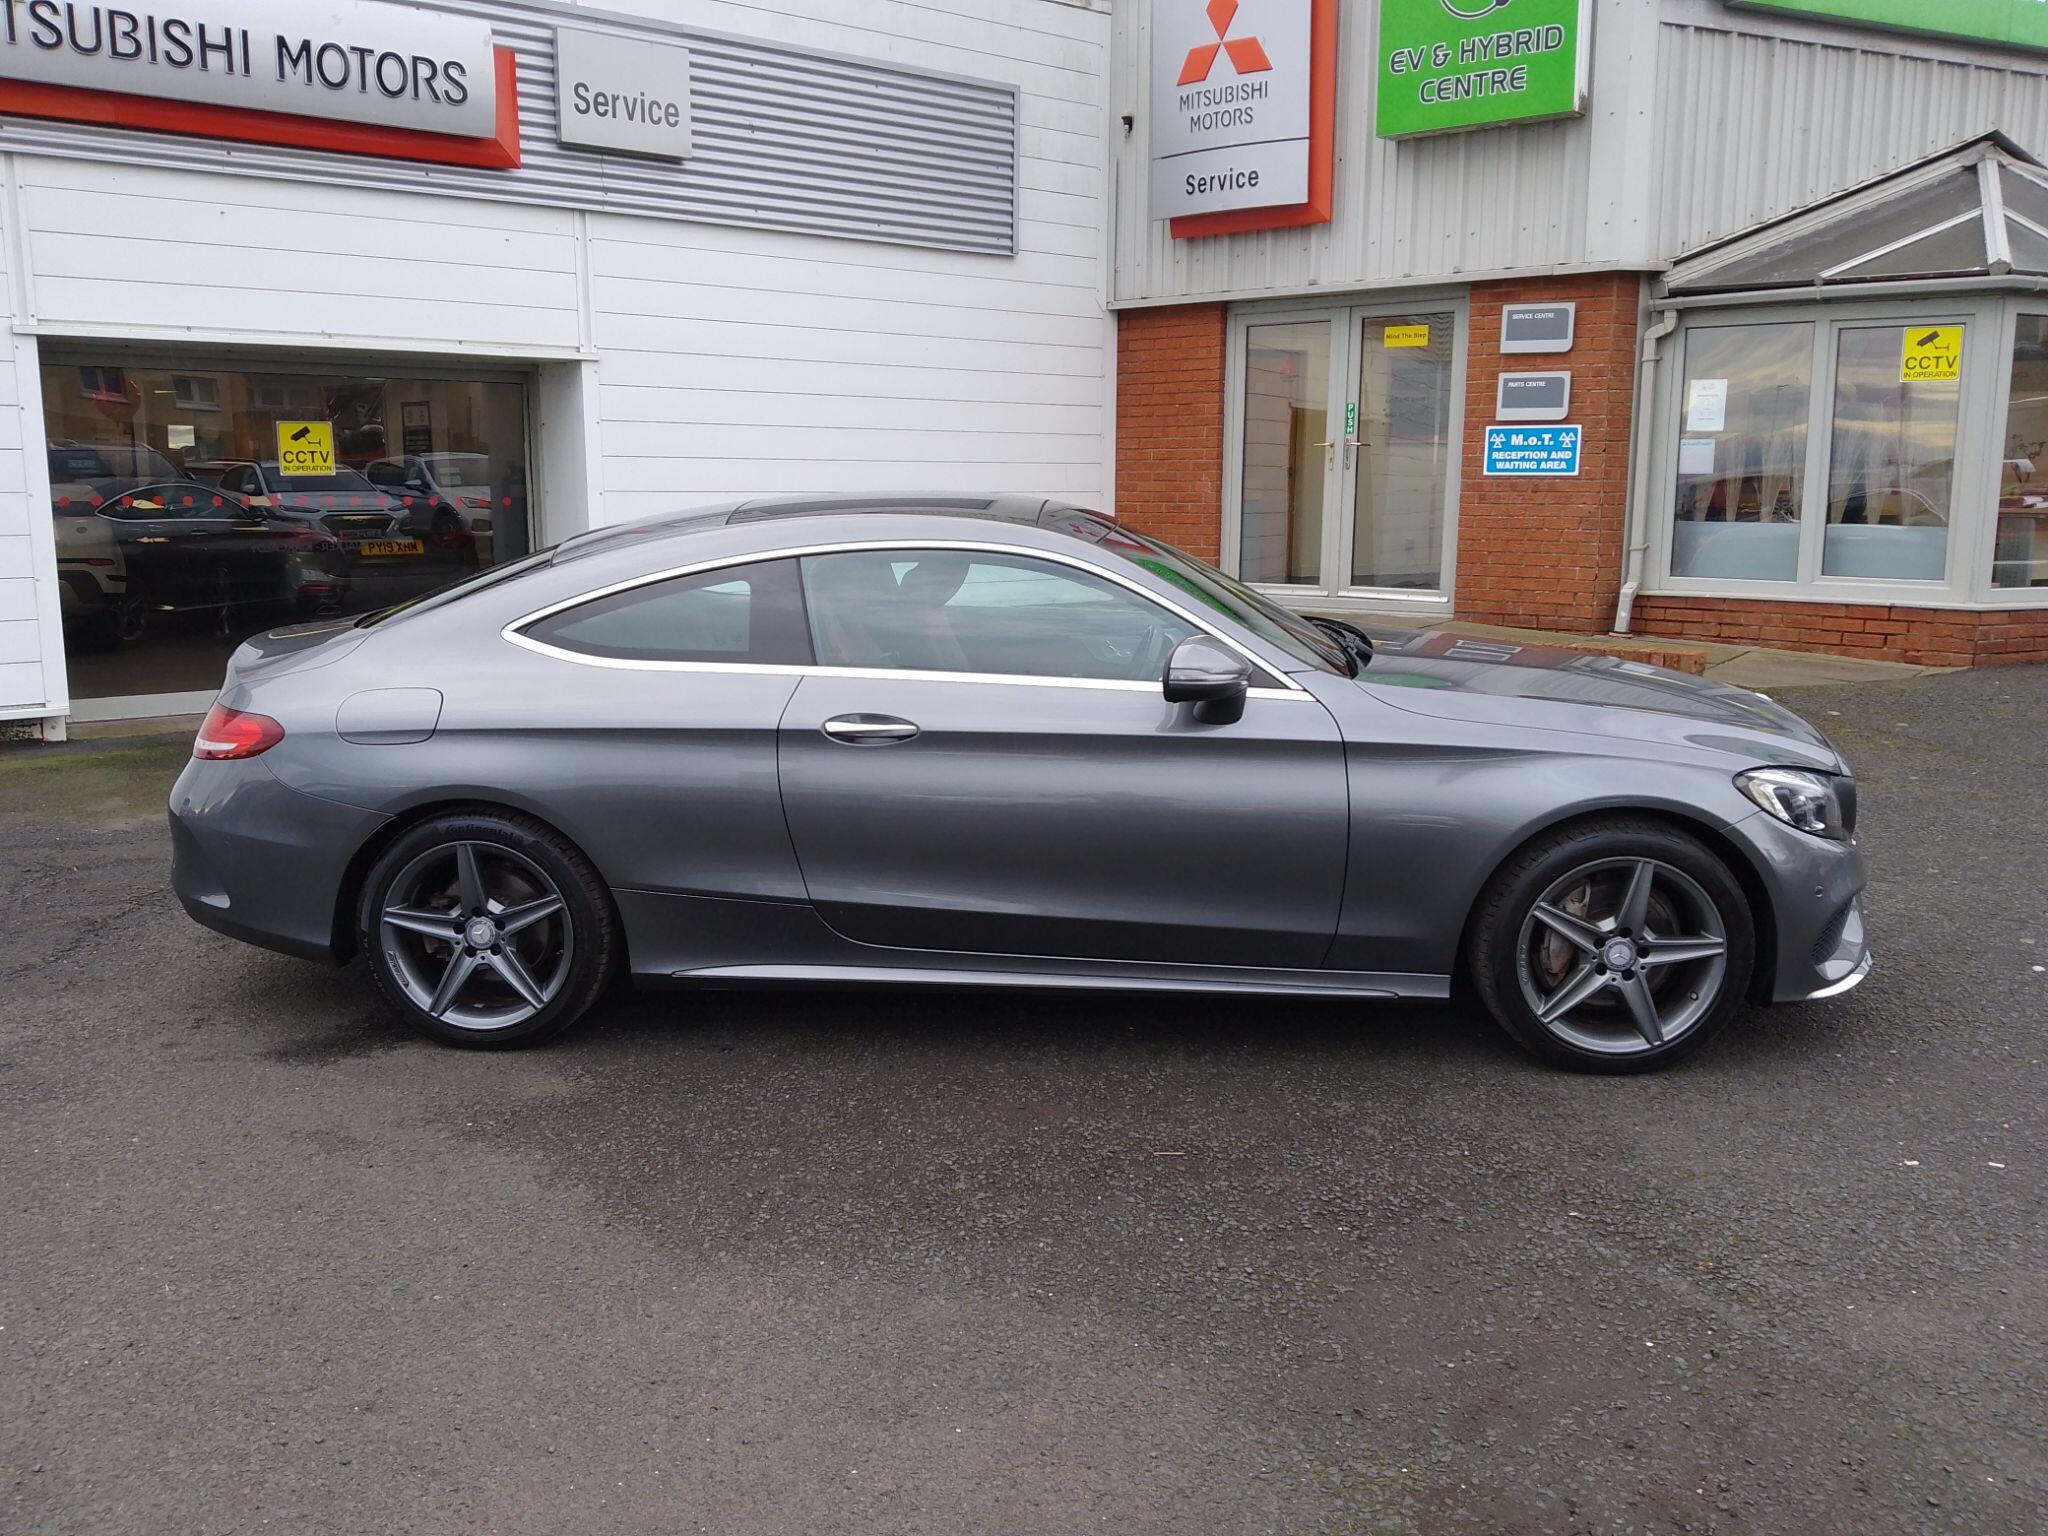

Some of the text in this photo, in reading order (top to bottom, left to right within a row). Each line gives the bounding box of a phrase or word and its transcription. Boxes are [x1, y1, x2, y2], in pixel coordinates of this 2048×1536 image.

[1389, 24, 1565, 75] EV & HYBRID
[275, 33, 470, 106] MOTORS
[1179, 80, 1269, 113] MITSUBISHI
[1419, 65, 1528, 104] CENTRE
[572, 82, 681, 128] Service
[1190, 106, 1254, 133] MOTORS
[1185, 167, 1260, 196] Service
[1904, 355, 1958, 370] CCTV
[1913, 370, 1957, 378] OPERATION
[1346, 403, 1354, 434] PUSH
[1510, 433, 1555, 446] M.o.T.
[283, 450, 330, 464] CCTV
[1492, 450, 1573, 460] RECEPTION AND
[1496, 460, 1567, 470] WAITING AREA
[368, 542, 394, 553] PY19
